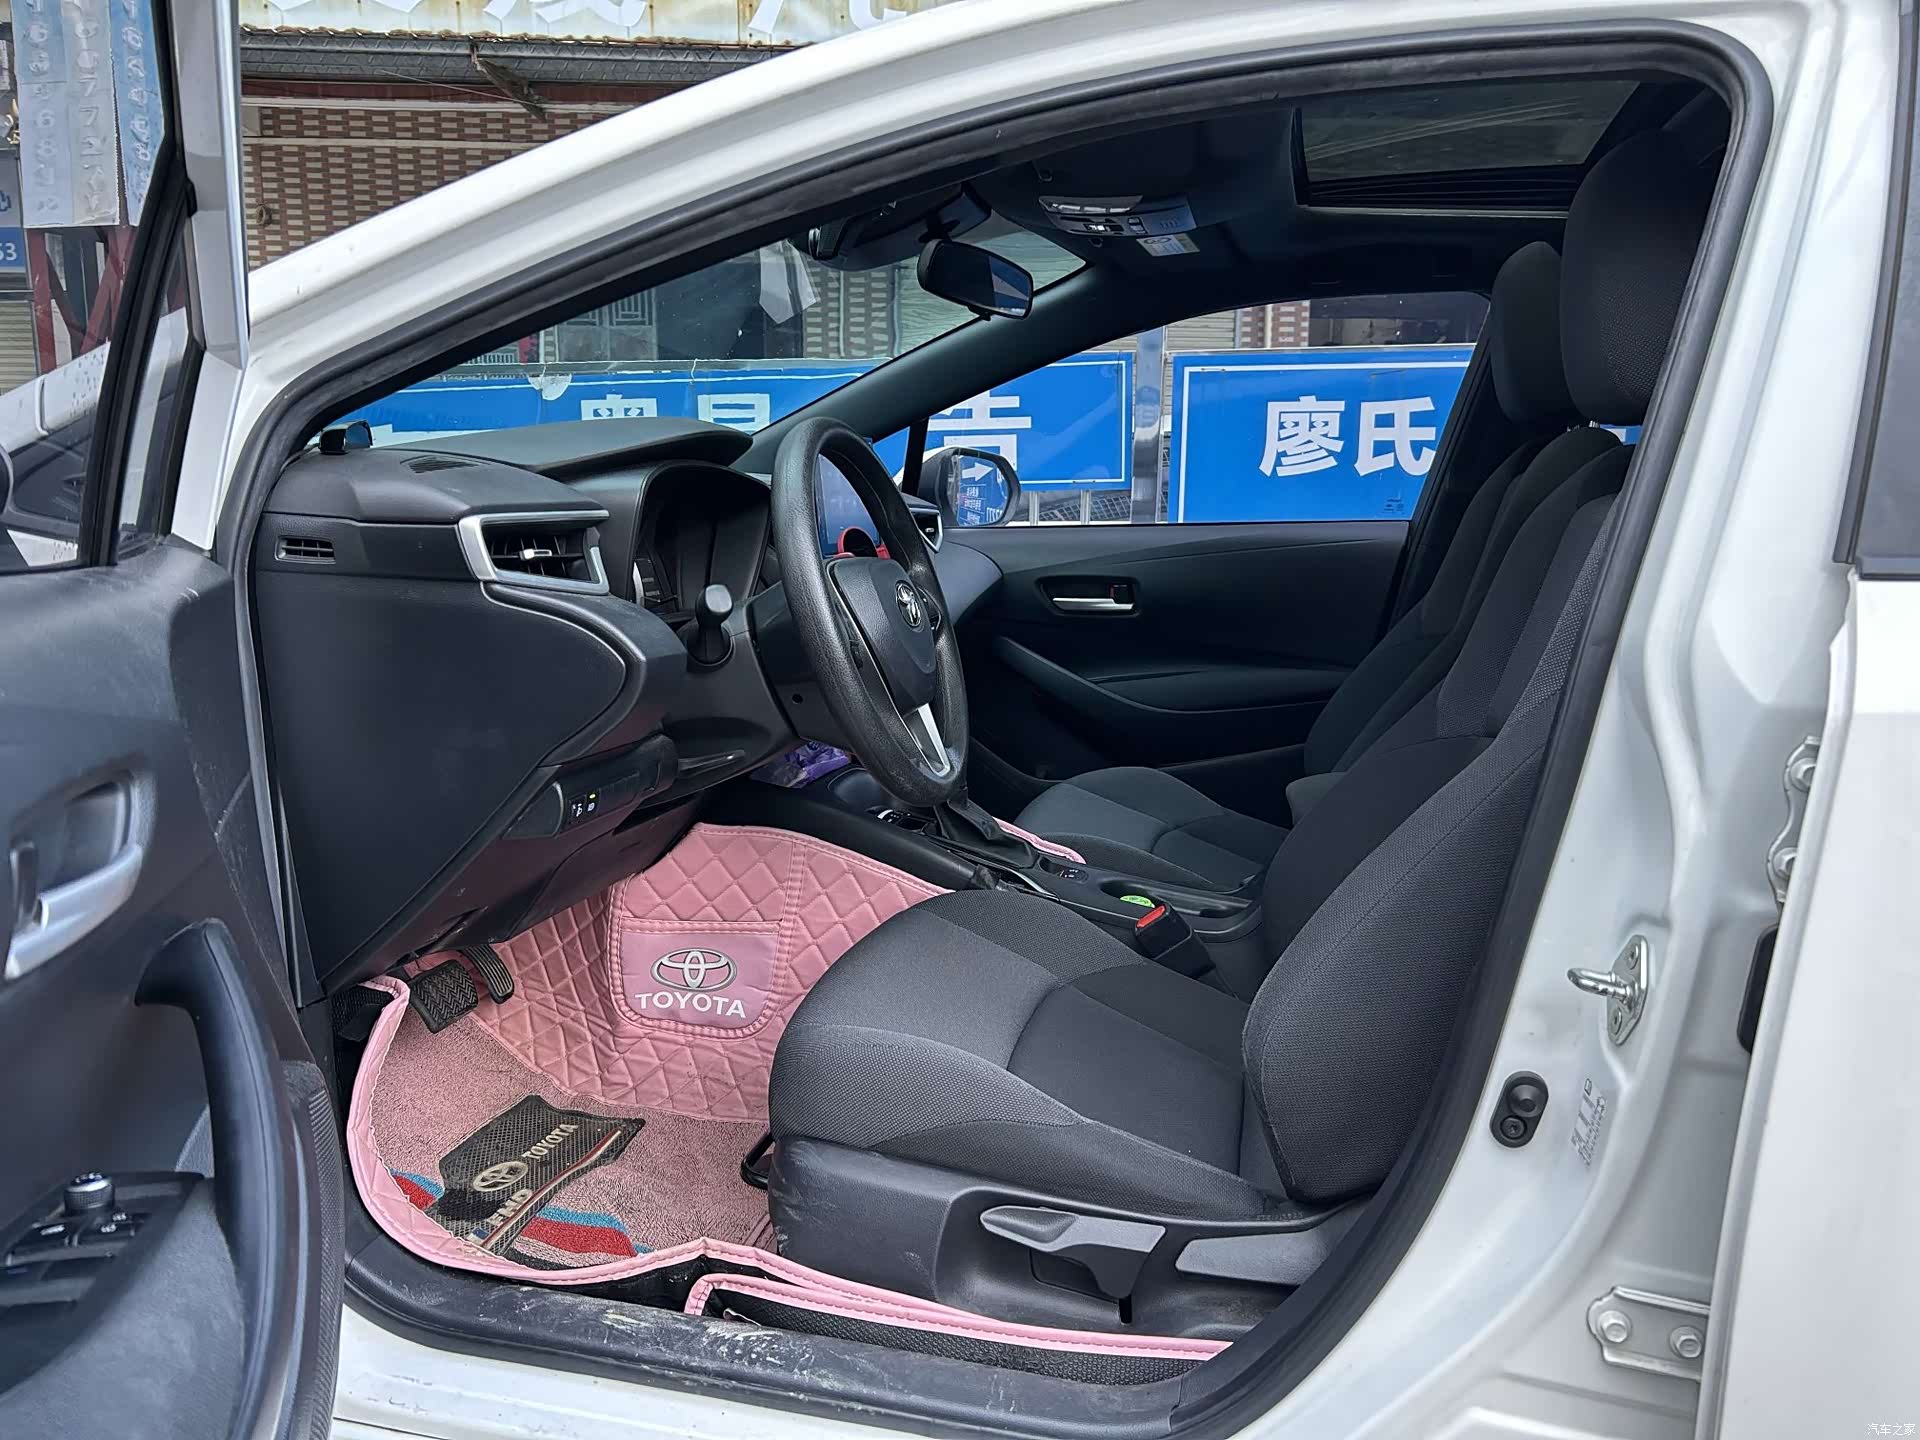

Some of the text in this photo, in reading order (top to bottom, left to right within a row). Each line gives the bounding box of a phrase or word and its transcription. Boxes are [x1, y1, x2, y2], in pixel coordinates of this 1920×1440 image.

[1259, 395, 1437, 477] 廖氏
[634, 991, 747, 1019] TOYOTA
[522, 1123, 579, 1160] TOYOTA
